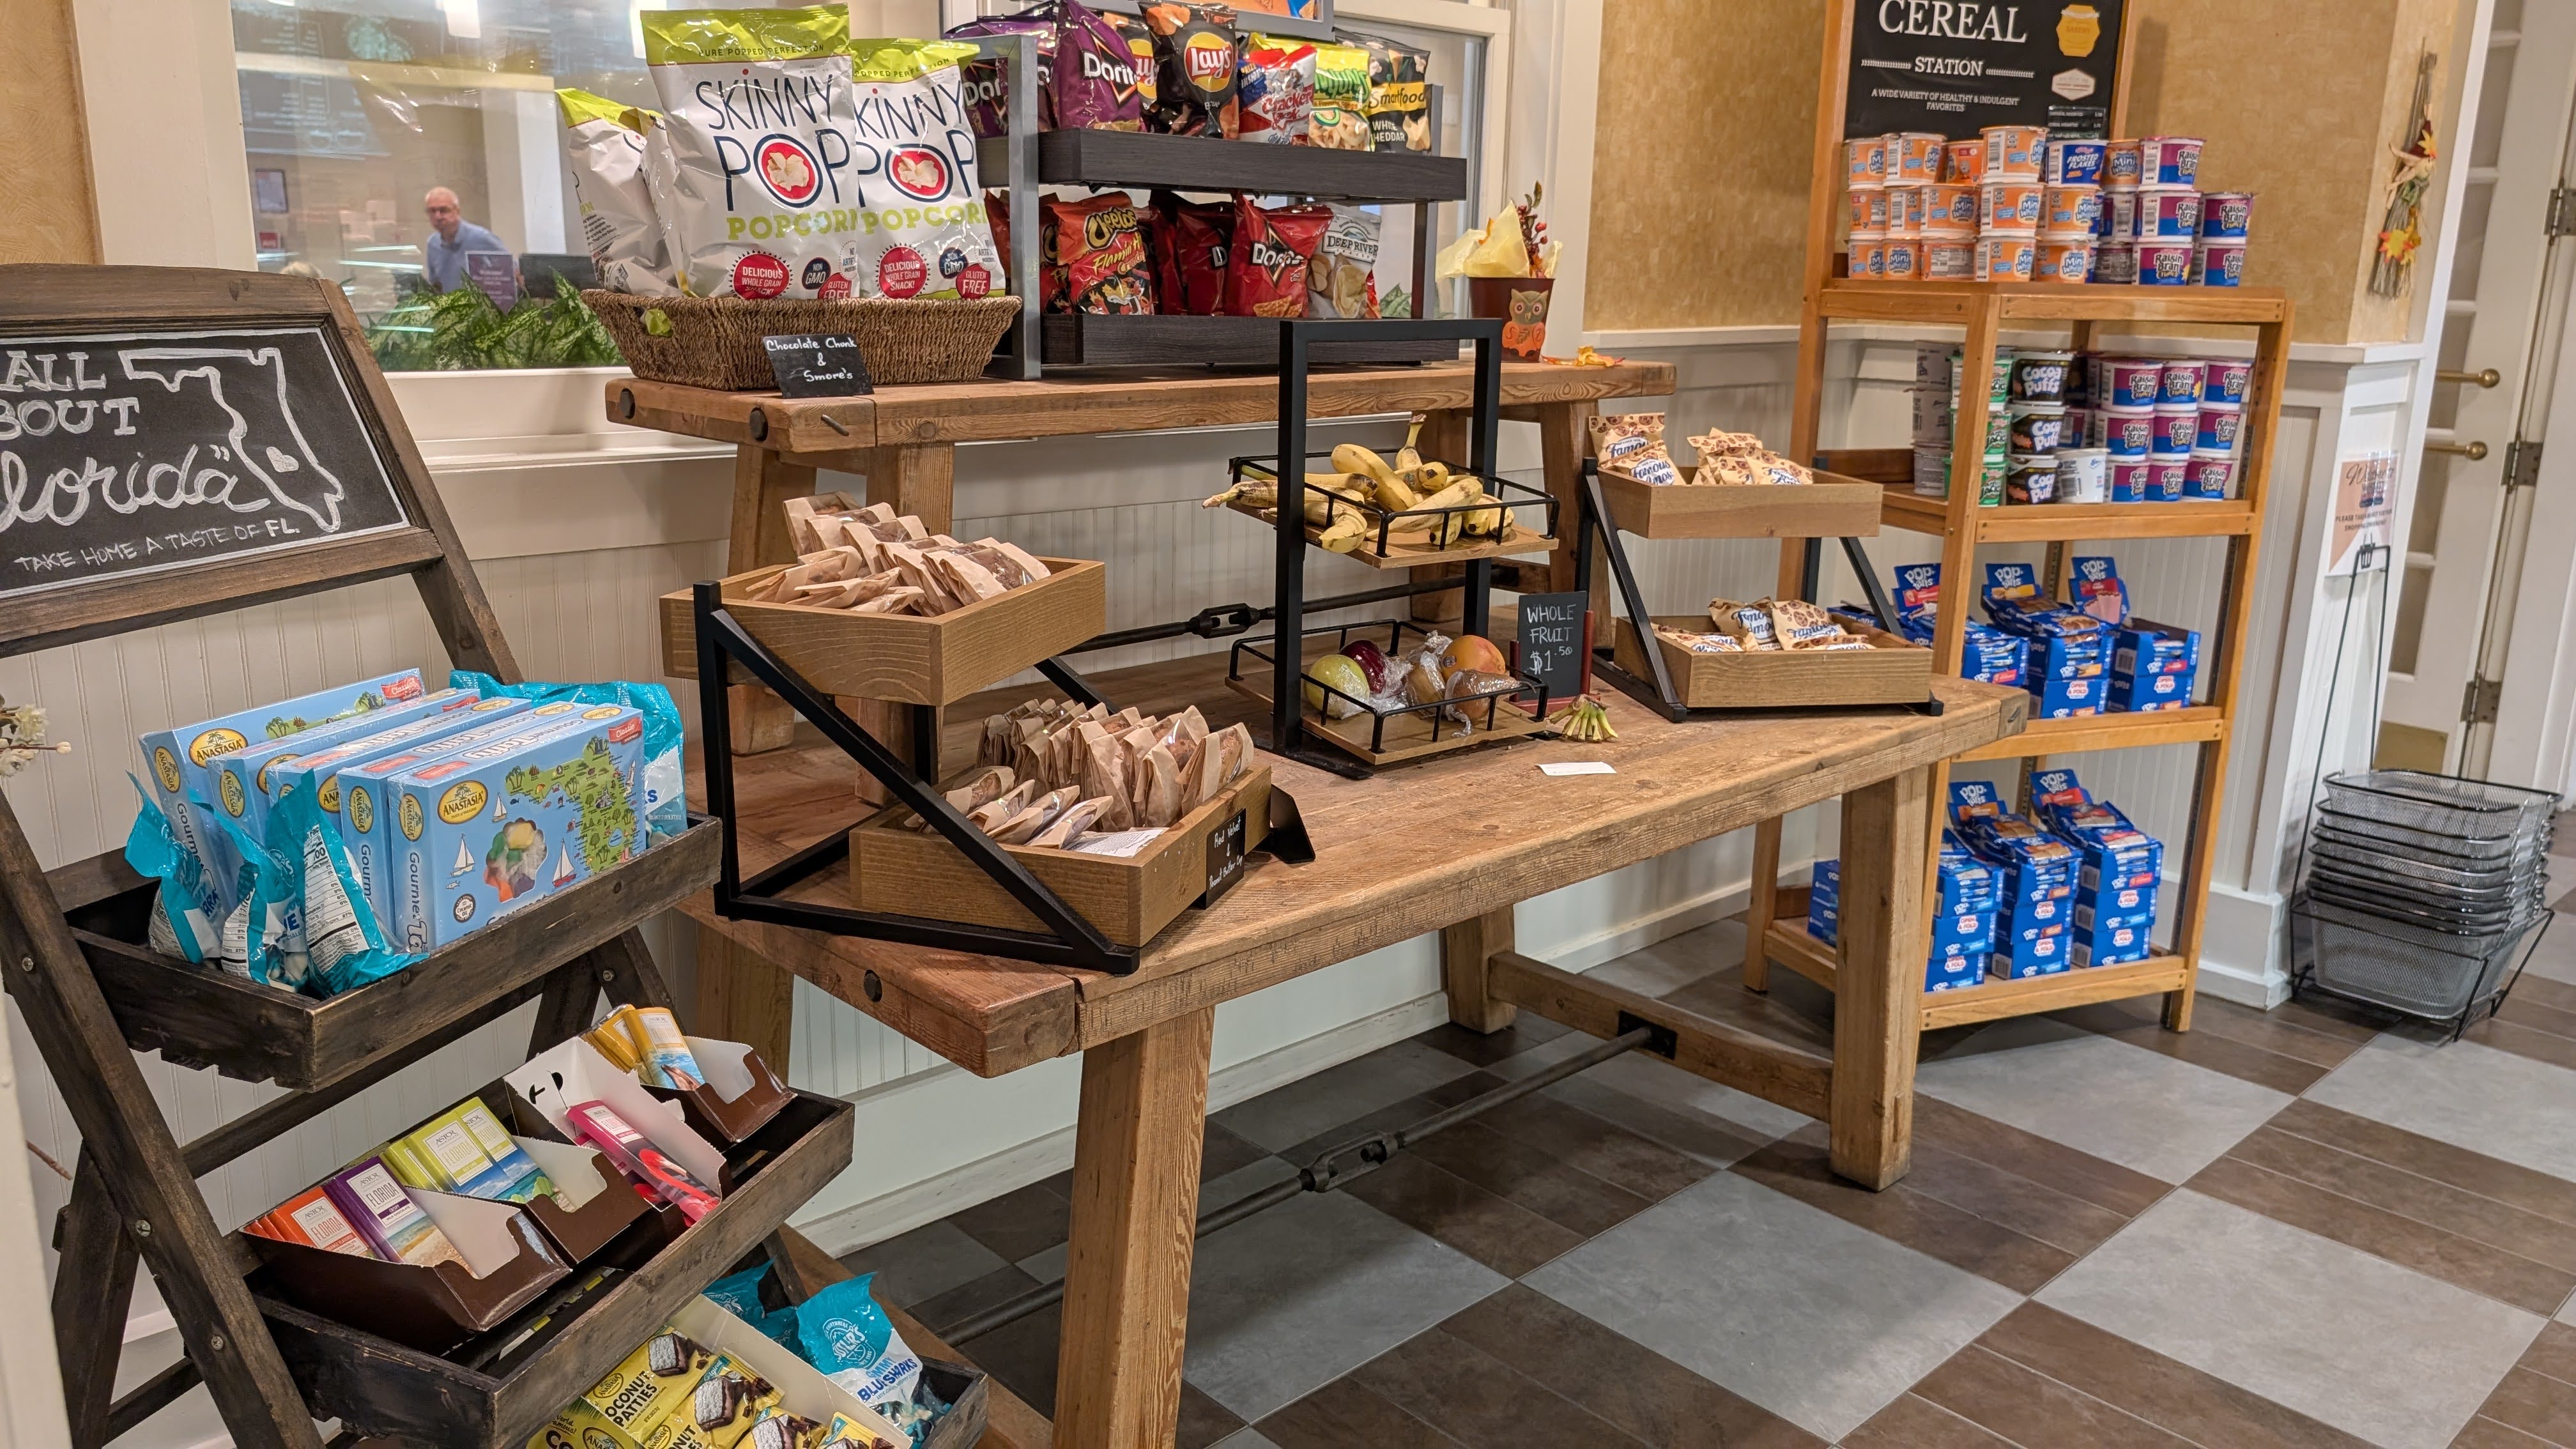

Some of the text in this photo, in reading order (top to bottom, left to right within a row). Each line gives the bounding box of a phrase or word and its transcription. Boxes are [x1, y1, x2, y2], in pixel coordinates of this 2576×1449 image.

[1879, 0, 2027, 43] CEREAL
[698, 44, 825, 57] PURE POPPED PERFECTION
[893, 57, 949, 78] PERFETION
[1084, 51, 1137, 86] Dorit
[1190, 43, 1232, 79] Lay's
[1915, 56, 1983, 76] STATION
[695, 68, 833, 131] SKINNY
[1262, 91, 1313, 114] Cracker
[1871, 88, 2020, 106] A WIDE VARIETY OF HEALTHY & INDULGENT
[854, 79, 962, 139] KINNY
[1926, 101, 1966, 112] FAVORITES
[1372, 119, 1398, 132] WHITE
[1371, 132, 1406, 142] HEDDAR
[2066, 153, 2099, 164] FROSTED
[2068, 160, 2096, 170] FLAKES
[2113, 157, 2136, 166] Mini
[713, 128, 850, 212] POP
[855, 129, 974, 208] POP
[2221, 204, 2248, 215] Raisin
[2223, 213, 2244, 223] Bran
[1087, 207, 1137, 248] Cheetos
[1326, 235, 1379, 257] DEEP RIVER
[884, 260, 920, 273] DELICIOUS
[1889, 254, 1910, 264] Mini
[2154, 254, 2183, 264] Raisin
[742, 266, 783, 280] DELICIOUS
[813, 263, 823, 272] NON
[965, 270, 986, 279] GLUTEN
[2157, 263, 2179, 272] Bran
[741, 277, 782, 288] WHOLE GRAIN
[805, 271, 826, 285] GMO
[827, 281, 848, 289] GLUTEN
[822, 289, 849, 299] FREE
[890, 281, 915, 292] SNACK!
[962, 281, 987, 295] FREE
[766, 337, 820, 351] Chocolate
[817, 352, 826, 367] &
[0, 350, 107, 392] ALL
[803, 367, 854, 382] Smore's
[2021, 365, 2062, 382] Cocoa
[2166, 372, 2193, 385] Raisin
[2024, 379, 2060, 399] Puffs
[2133, 383, 2152, 393] Bran
[2168, 383, 2189, 392] Bran
[0, 397, 141, 441] BOUT
[2031, 420, 2062, 436] Coco
[2124, 425, 2149, 436] Raisin
[2033, 433, 2059, 453] Puff
[2126, 433, 2147, 443] Bran
[2028, 473, 2055, 489] Coco
[2202, 477, 2222, 486] Bran
[2030, 483, 2054, 503] Puff
[14, 518, 301, 572] TAKE HOME A TASTE OF FL.
[1526, 603, 1577, 624] WHOLE
[1529, 626, 1574, 644] FRUIT
[1529, 645, 1573, 675] $1.50
[615, 723, 636, 738] Classic
[195, 738, 245, 762] ANASTASIA
[157, 751, 176, 790] ANASTASIA
[355, 790, 366, 831] ANASTASIA
[443, 790, 484, 817] ANASTASIA
[404, 797, 415, 838] ANASTASIA
[1214, 815, 1241, 848] Red Velvet
[1223, 860, 1236, 878] Butter
[465, 1115, 482, 1126] STOR
[435, 1130, 457, 1145] ASTOR
[476, 1124, 500, 1145] ORIDA
[441, 1139, 475, 1167] FLORIDA
[360, 1172, 380, 1186] ASTOR
[365, 1181, 400, 1208] FLORIDA
[304, 1205, 327, 1220] ASTOR
[310, 1215, 345, 1241] FLORIDA
[865, 1356, 896, 1378] GMMY
[598, 1374, 621, 1398] ANASTASIA
[604, 1370, 650, 1418] OCONUT
[613, 1383, 657, 1428] PATTIES
